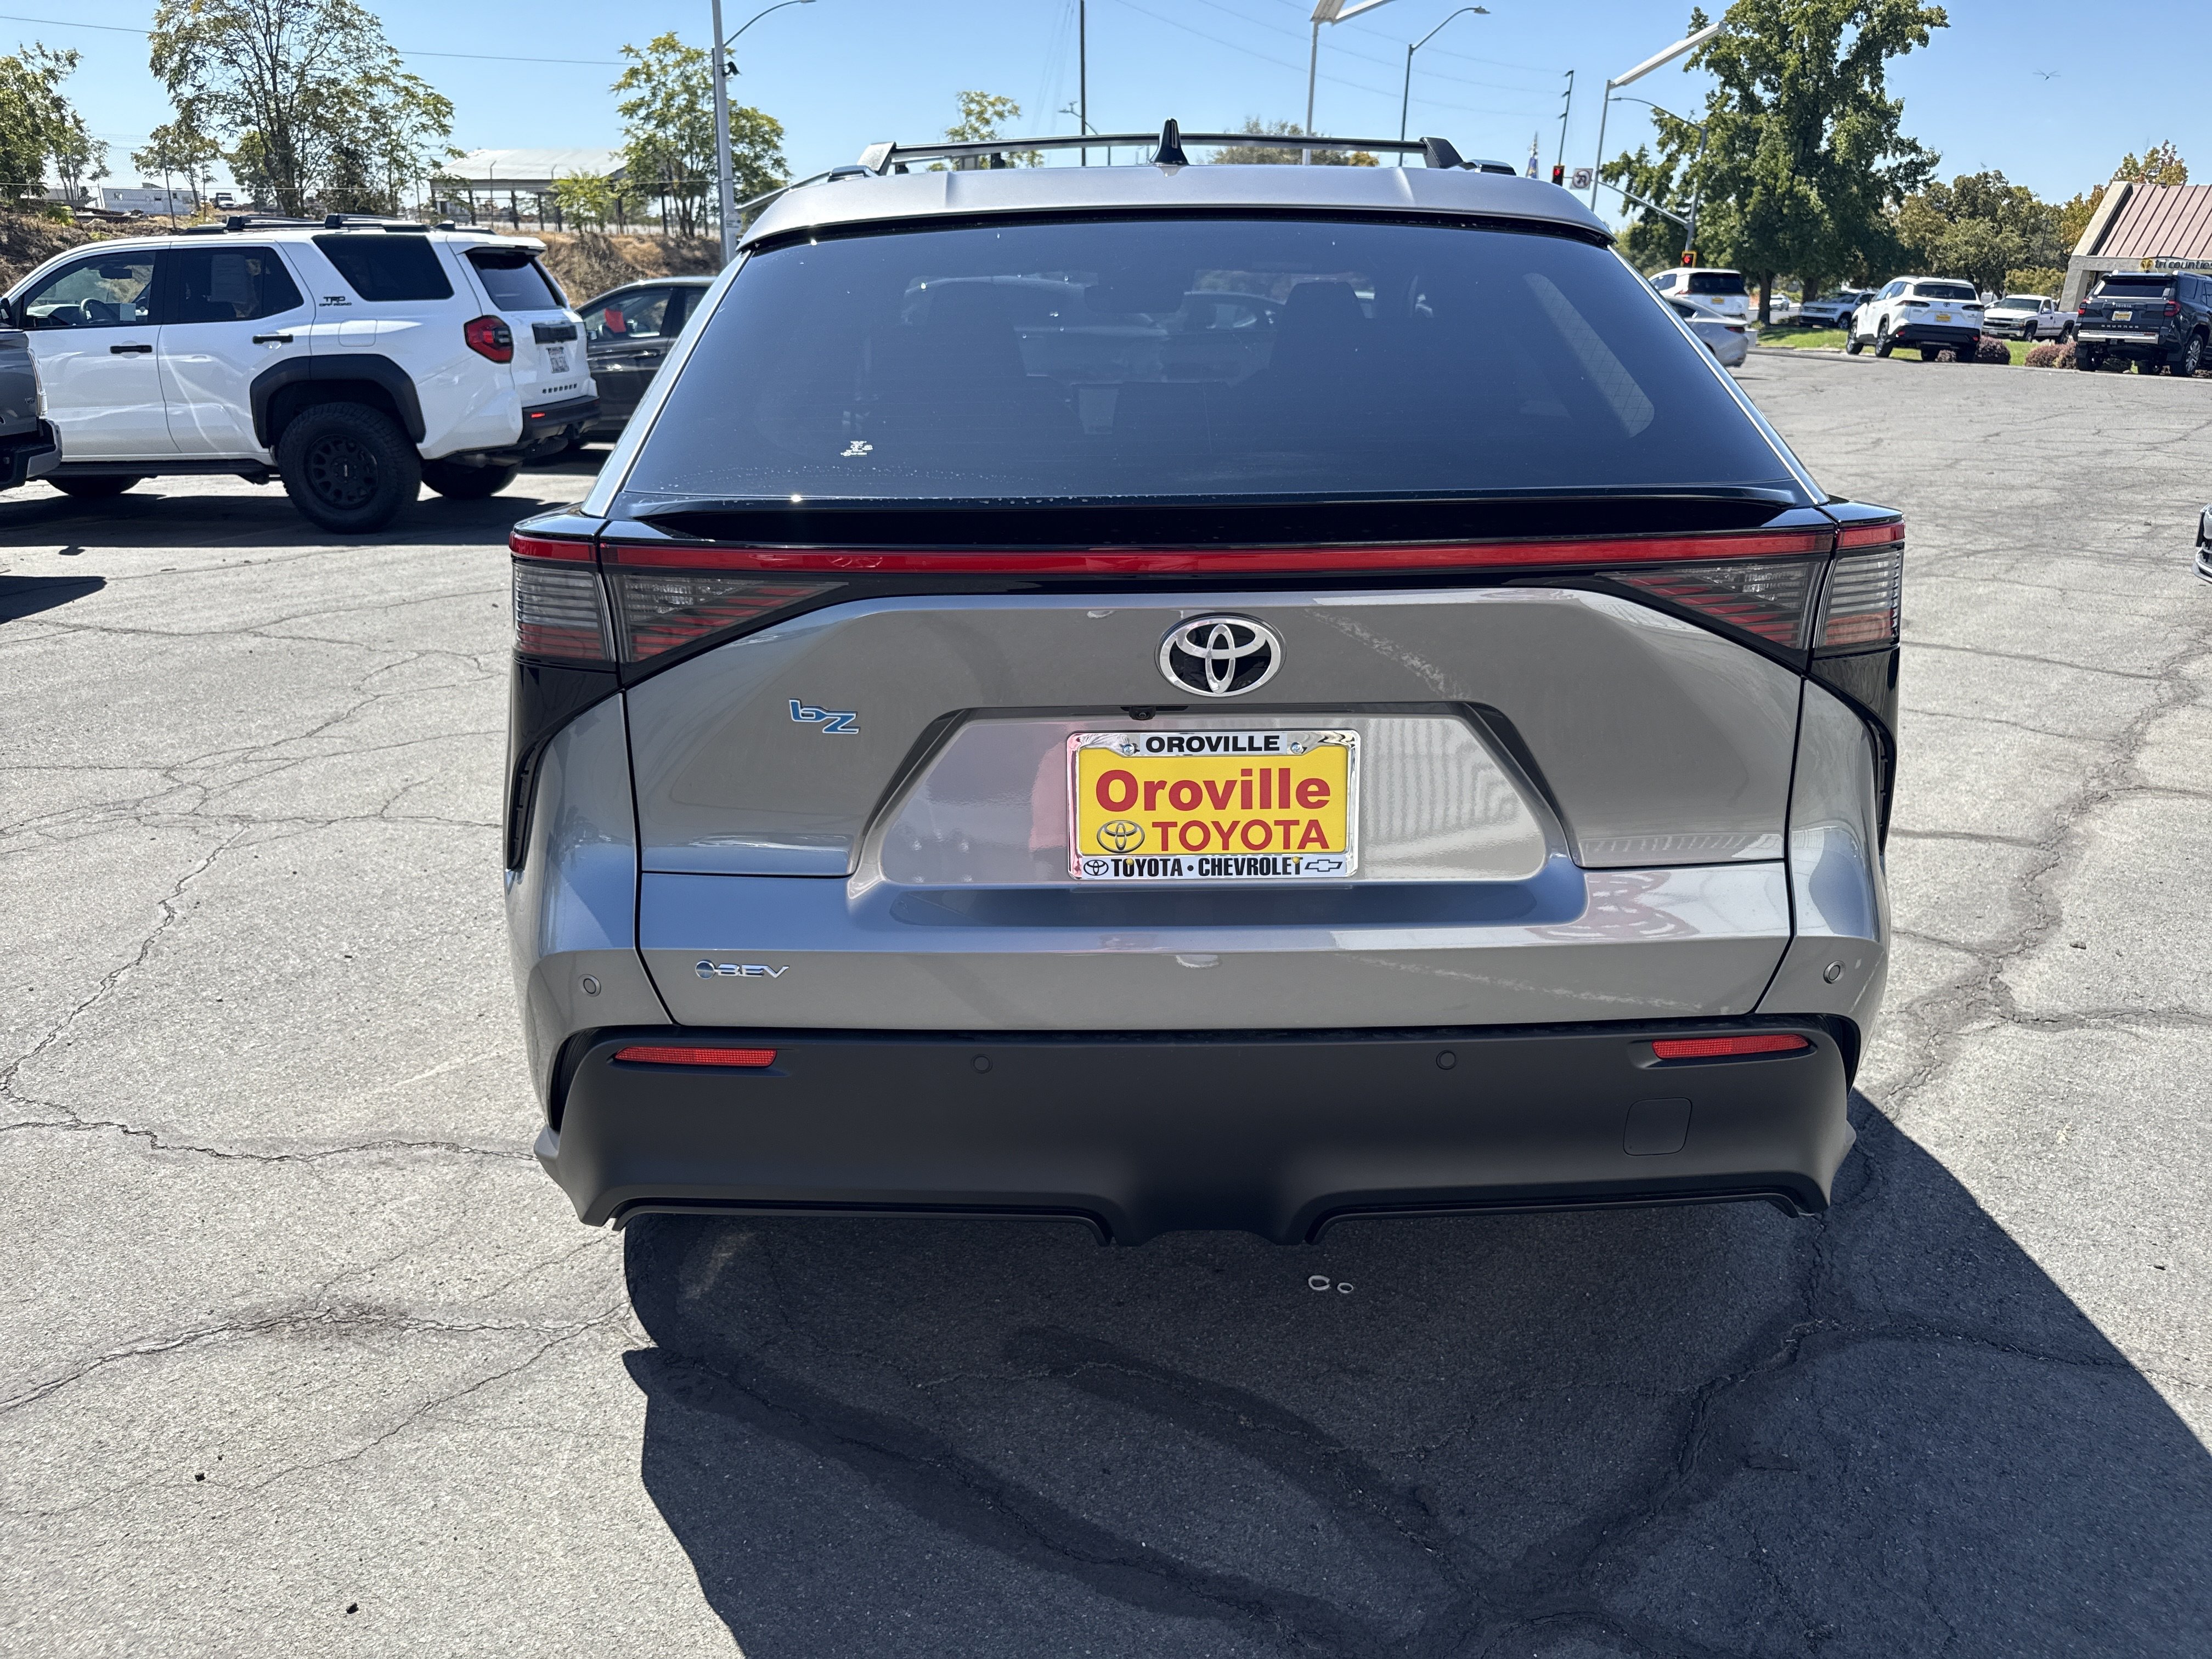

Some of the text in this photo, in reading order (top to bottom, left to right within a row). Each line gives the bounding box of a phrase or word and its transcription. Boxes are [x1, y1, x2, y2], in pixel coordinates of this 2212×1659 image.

[2155, 259, 2168, 268] tri
[1146, 735, 1280, 753] OROVILLE
[1096, 768, 1331, 812] Oroville
[1152, 819, 1330, 851] TOYOTA
[1111, 857, 1304, 877] TOYOTA CHEVROLET
